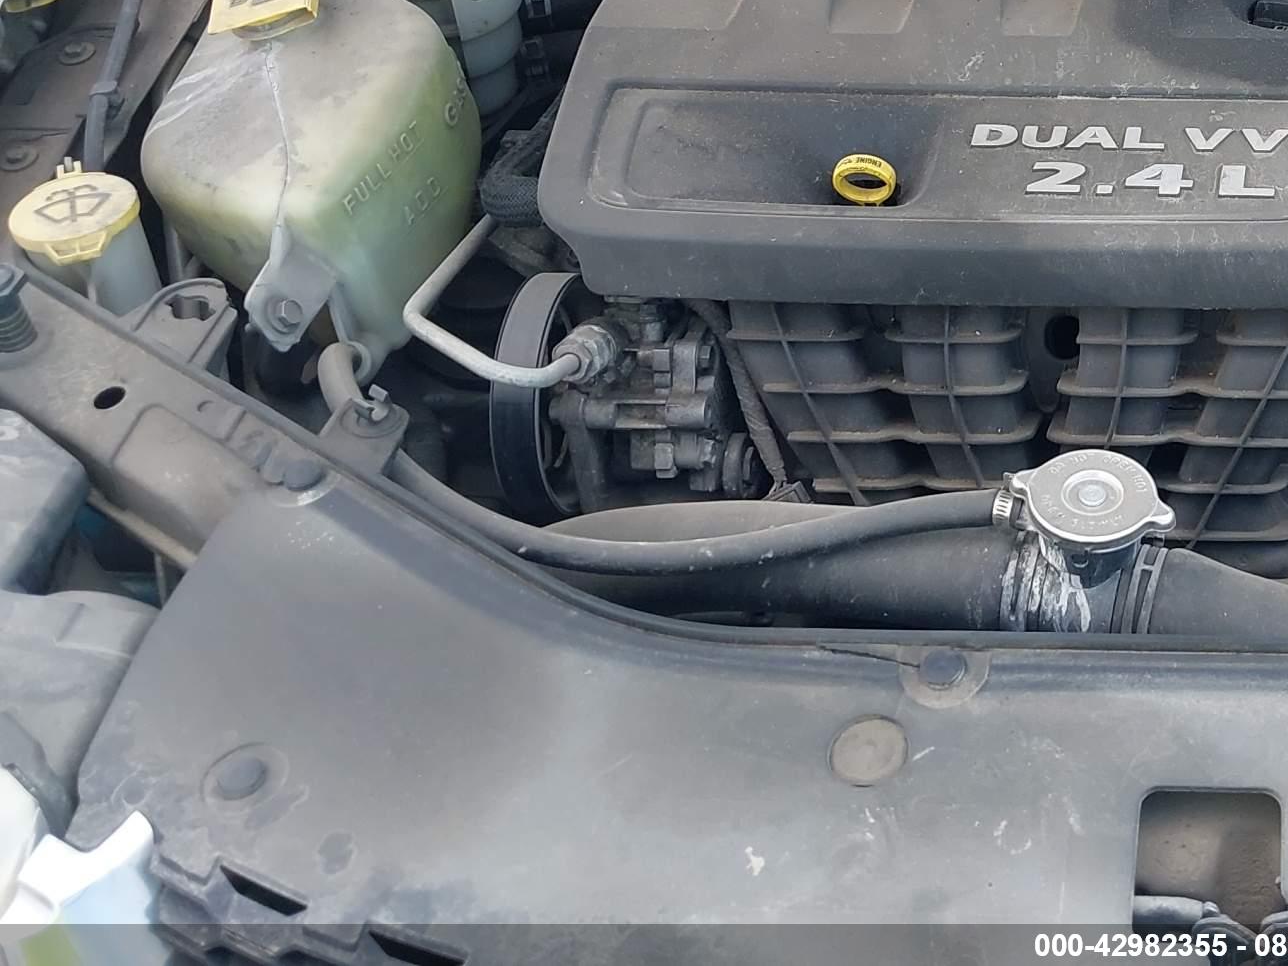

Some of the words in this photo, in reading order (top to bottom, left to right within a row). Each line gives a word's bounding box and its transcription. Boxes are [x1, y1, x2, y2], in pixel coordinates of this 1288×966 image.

[970, 123, 1165, 150] DUAL
[341, 163, 392, 215] FULL
[387, 120, 420, 163] HOT
[855, 156, 882, 168] ENGINE
